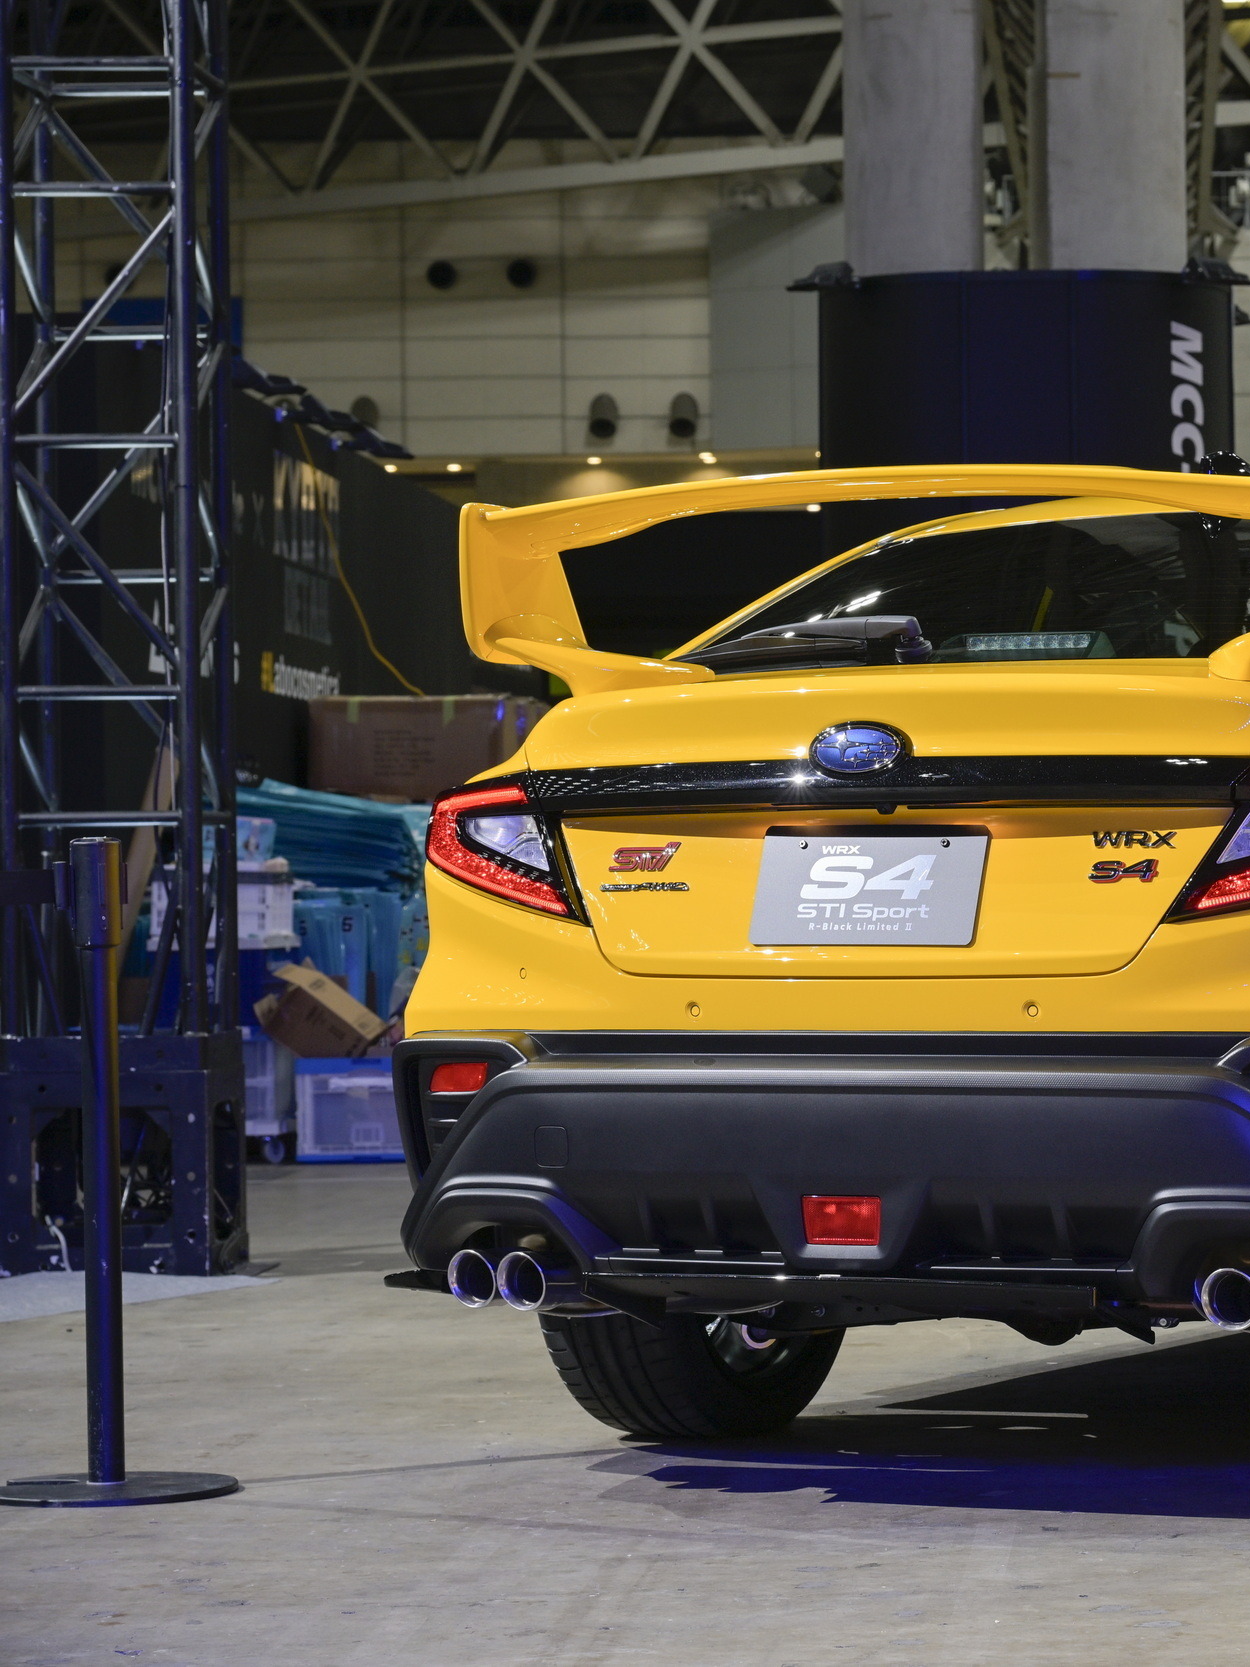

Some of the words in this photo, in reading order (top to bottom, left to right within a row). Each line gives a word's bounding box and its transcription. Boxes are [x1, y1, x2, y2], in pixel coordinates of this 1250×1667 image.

[1092, 831, 1177, 849] WRX
[822, 845, 860, 855] WRX
[800, 855, 937, 900] S4
[1088, 859, 1159, 883] S4
[797, 903, 846, 919] STI
[852, 903, 930, 922] Sport
[808, 922, 852, 931] R-Black
[857, 922, 899, 931] Limited
